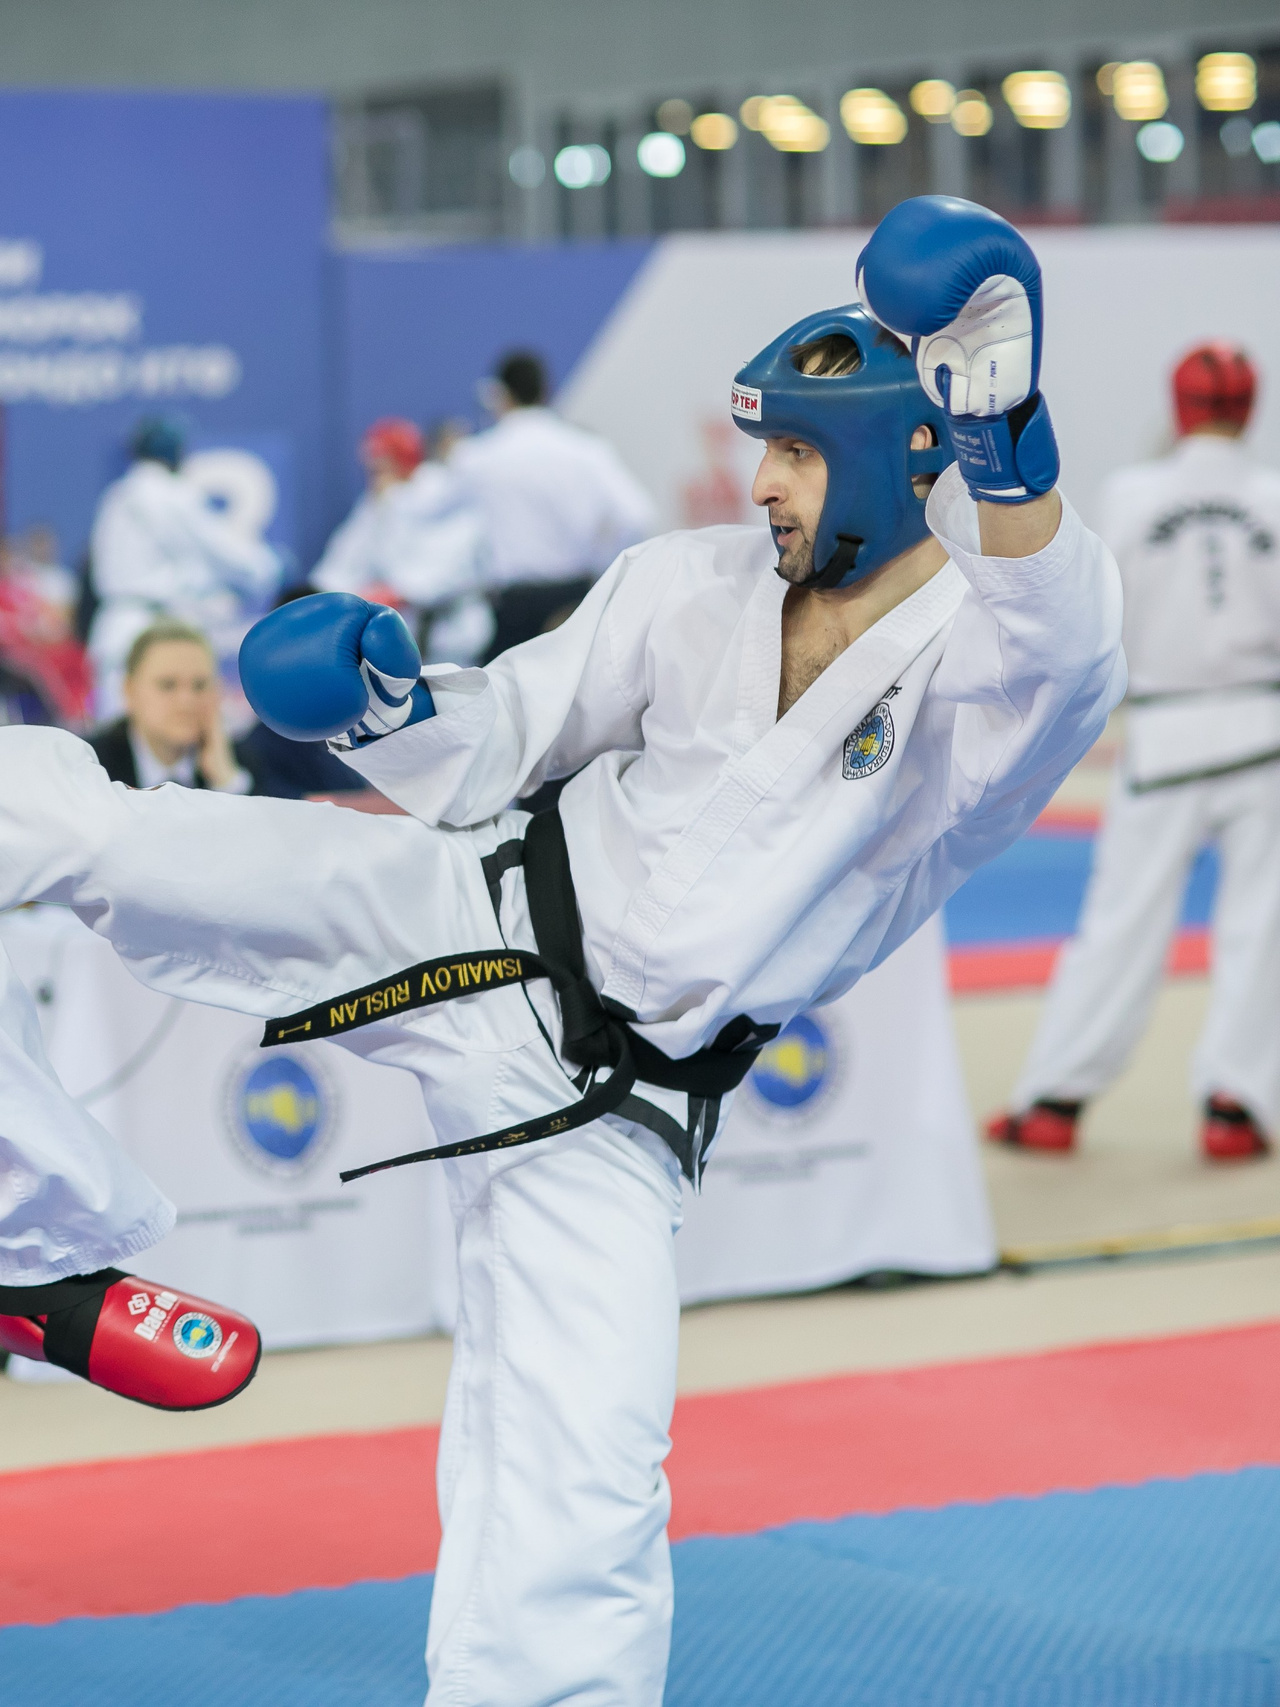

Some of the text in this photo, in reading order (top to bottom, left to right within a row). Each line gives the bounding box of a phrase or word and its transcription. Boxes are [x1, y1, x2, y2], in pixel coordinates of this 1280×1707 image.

[740, 395, 758, 410] TEN
[420, 958, 523, 998] ISMAILOV
[329, 980, 411, 1028] RUSLAN
